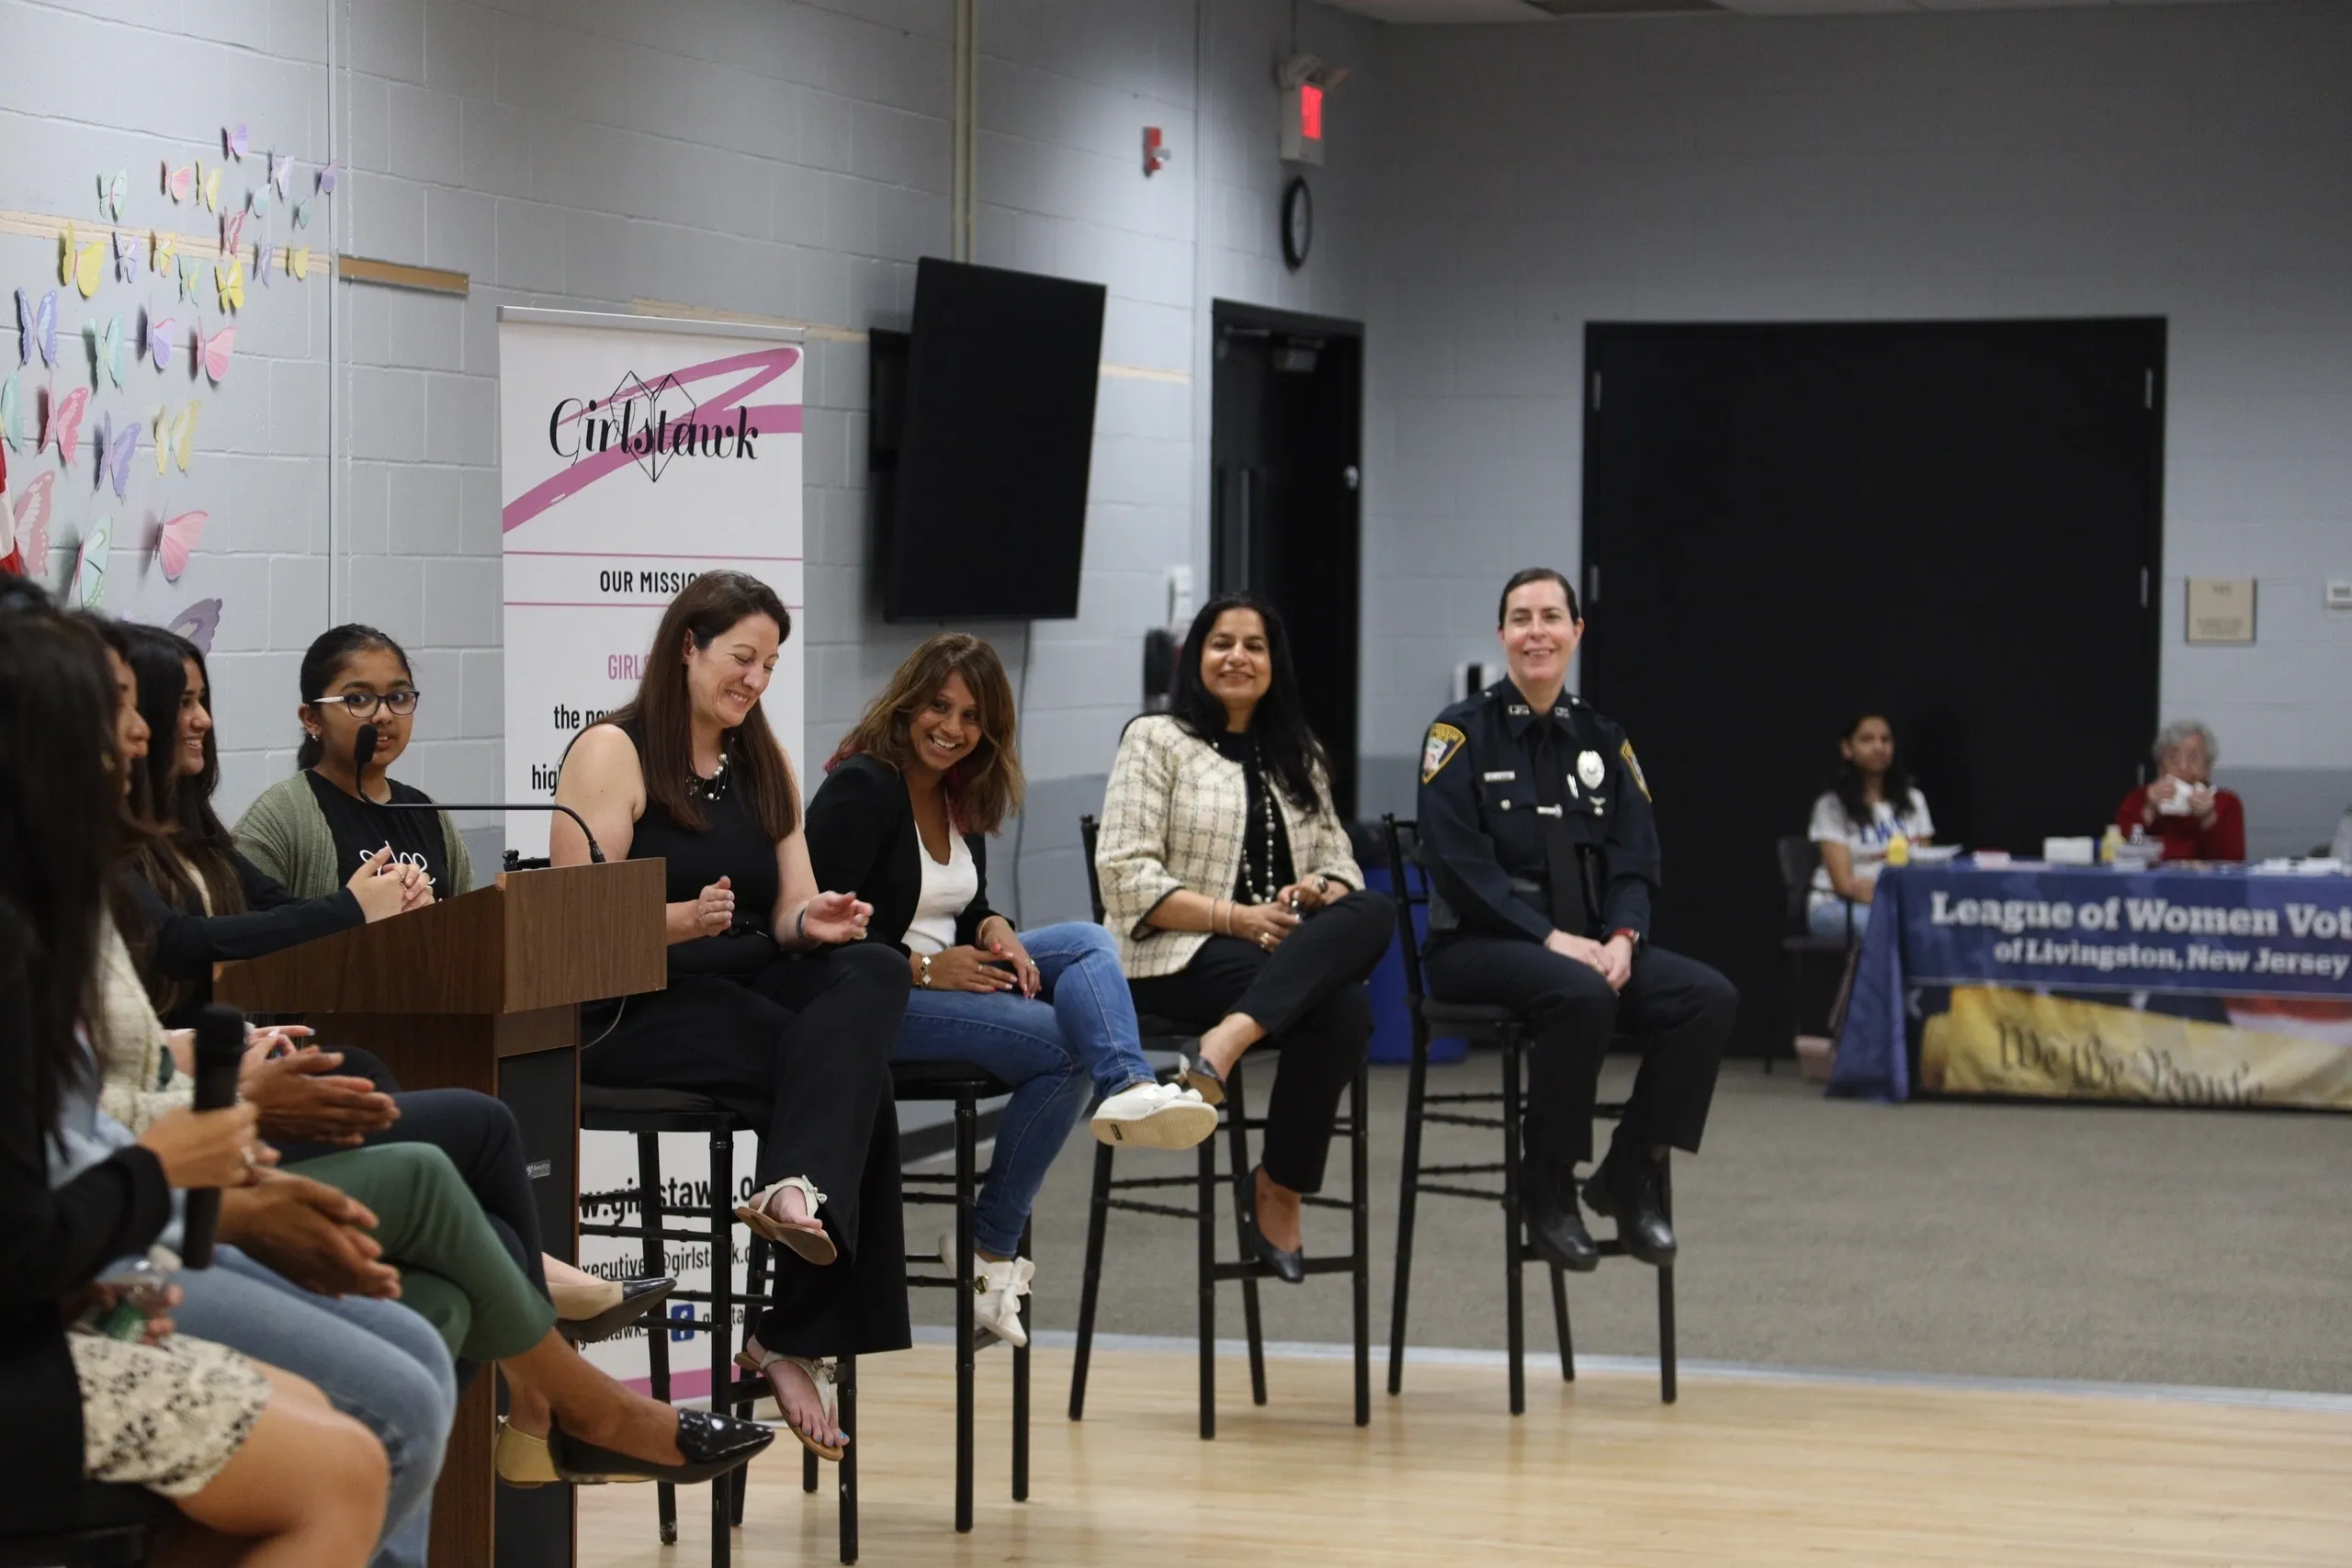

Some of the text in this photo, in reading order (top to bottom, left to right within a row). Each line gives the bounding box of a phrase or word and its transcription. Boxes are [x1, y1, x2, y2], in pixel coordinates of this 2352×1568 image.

[549, 398, 759, 467] Girlstawk
[600, 570, 633, 592] OUR
[553, 704, 581, 729] the
[531, 763, 561, 796] hig
[1930, 890, 2075, 934] League
[2078, 896, 2120, 931] of
[2125, 897, 2278, 938] Women
[1994, 937, 2350, 980] of Livingston, New Jersey
